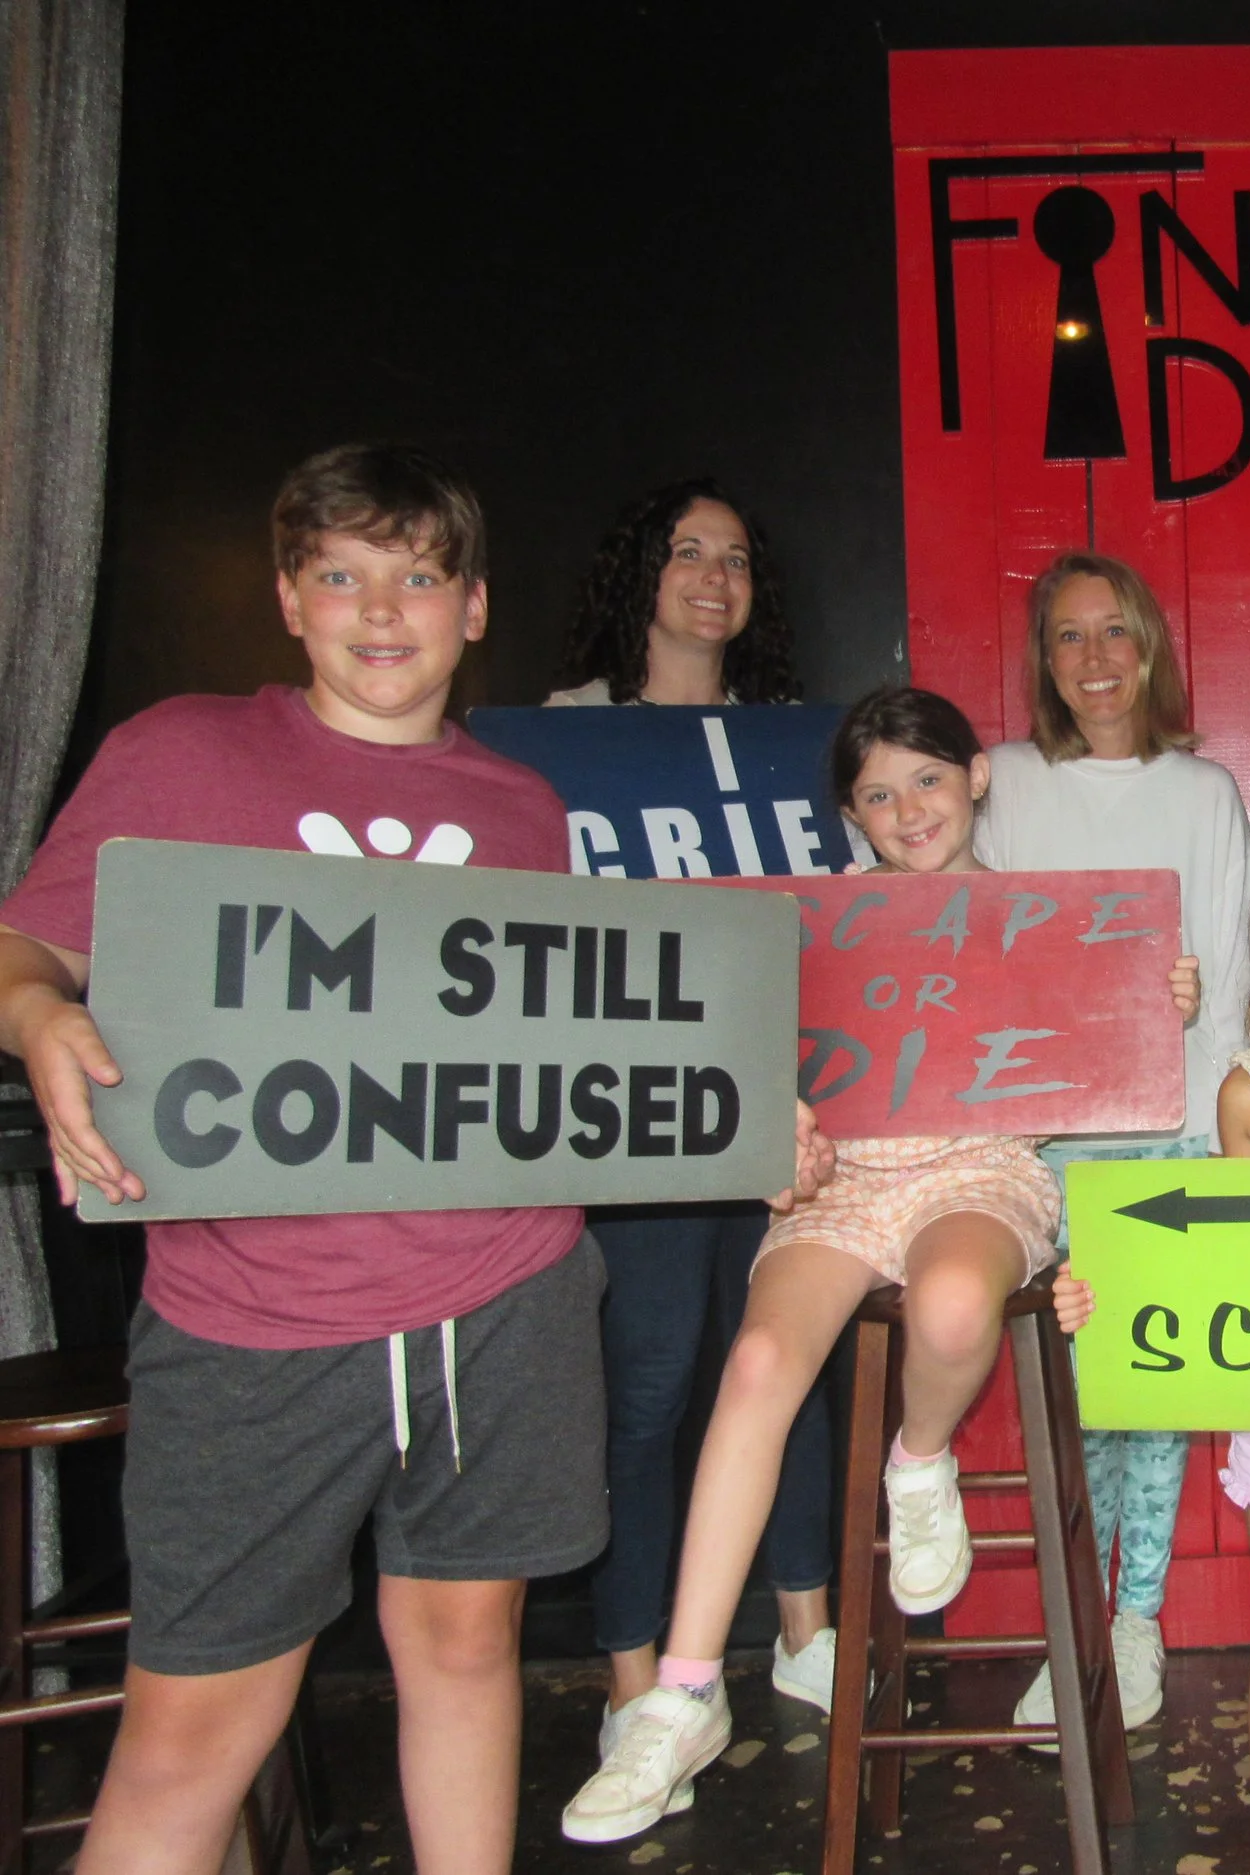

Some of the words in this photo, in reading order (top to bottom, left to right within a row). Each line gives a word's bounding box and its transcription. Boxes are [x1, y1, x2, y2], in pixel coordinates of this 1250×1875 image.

[702, 717, 740, 792] I
[213, 902, 377, 1013] I'M
[436, 917, 705, 1023] STILL
[797, 884, 1161, 960] CAPE
[863, 973, 960, 1015] OR
[152, 1057, 741, 1169] CONFUSED
[798, 1022, 1089, 1121] DIE
